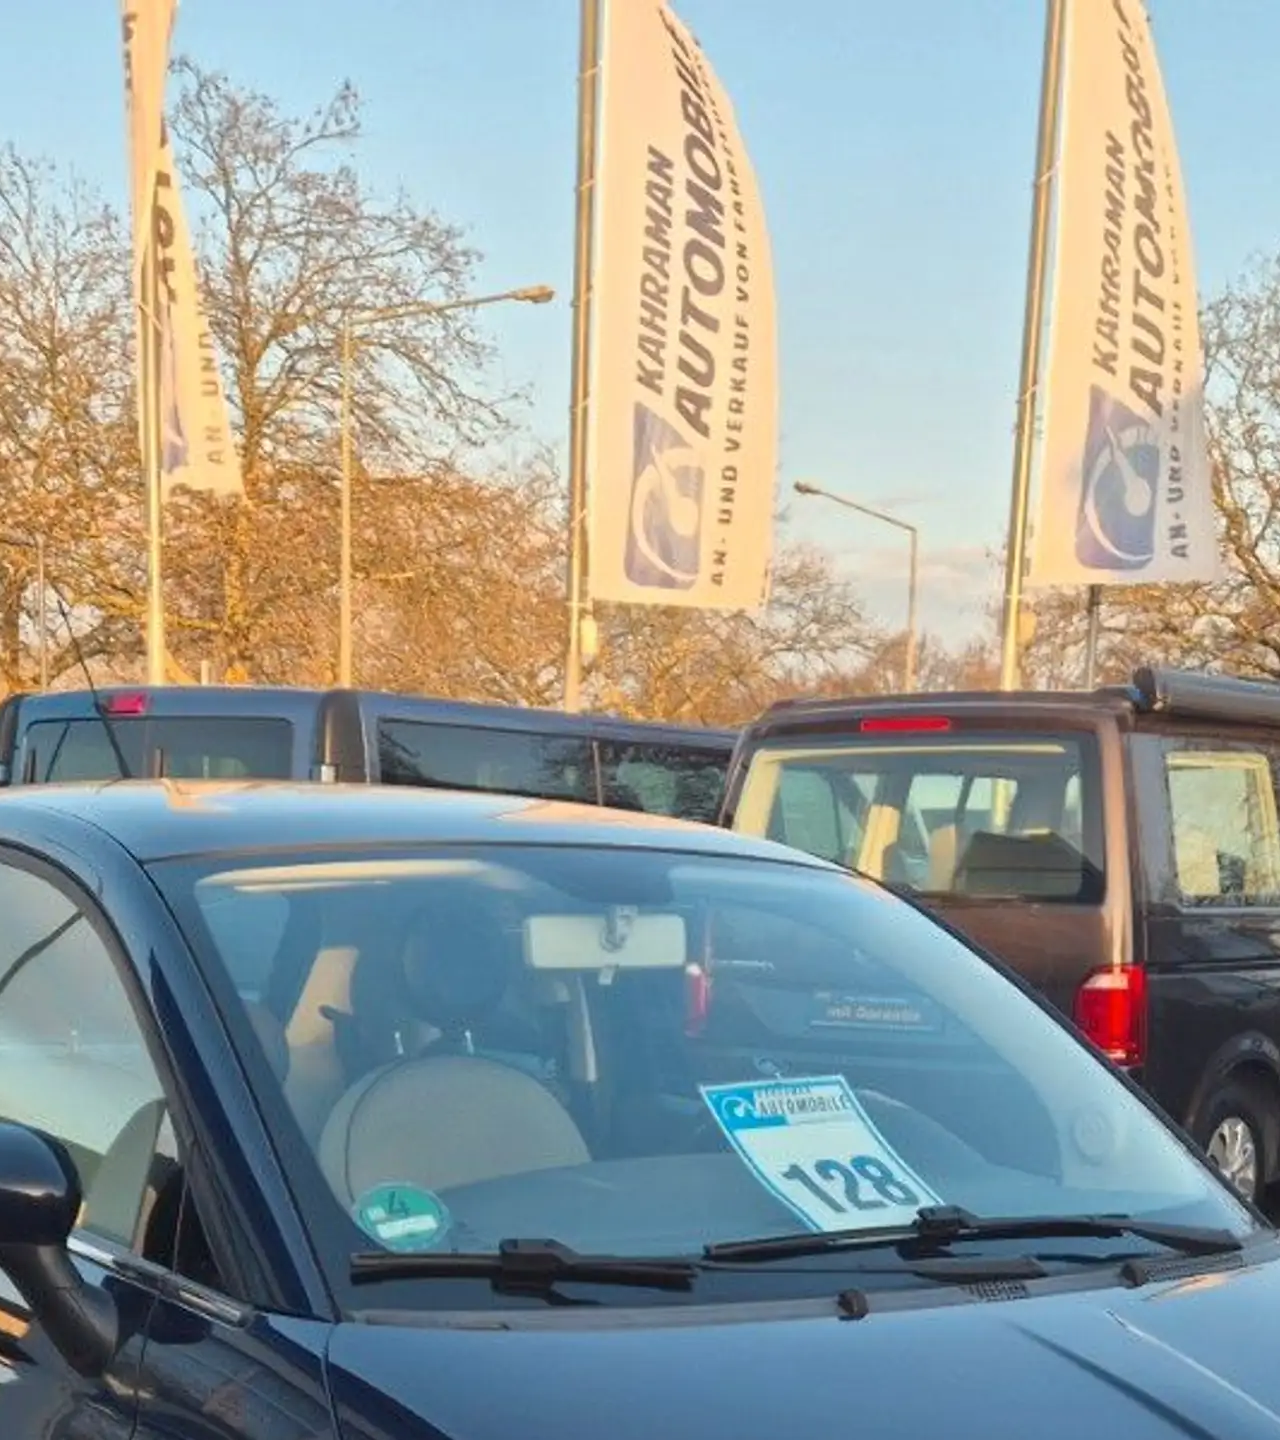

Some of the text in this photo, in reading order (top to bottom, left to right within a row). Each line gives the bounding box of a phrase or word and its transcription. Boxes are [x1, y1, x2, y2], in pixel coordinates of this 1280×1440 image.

[637, 146, 675, 396] KAHRAMAN
[734, 241, 753, 303] VON
[1092, 130, 1126, 376] KAHRAMAN
[724, 313, 752, 455] VERKAUF
[718, 464, 738, 525] UND
[781, 1155, 921, 1214] 128
